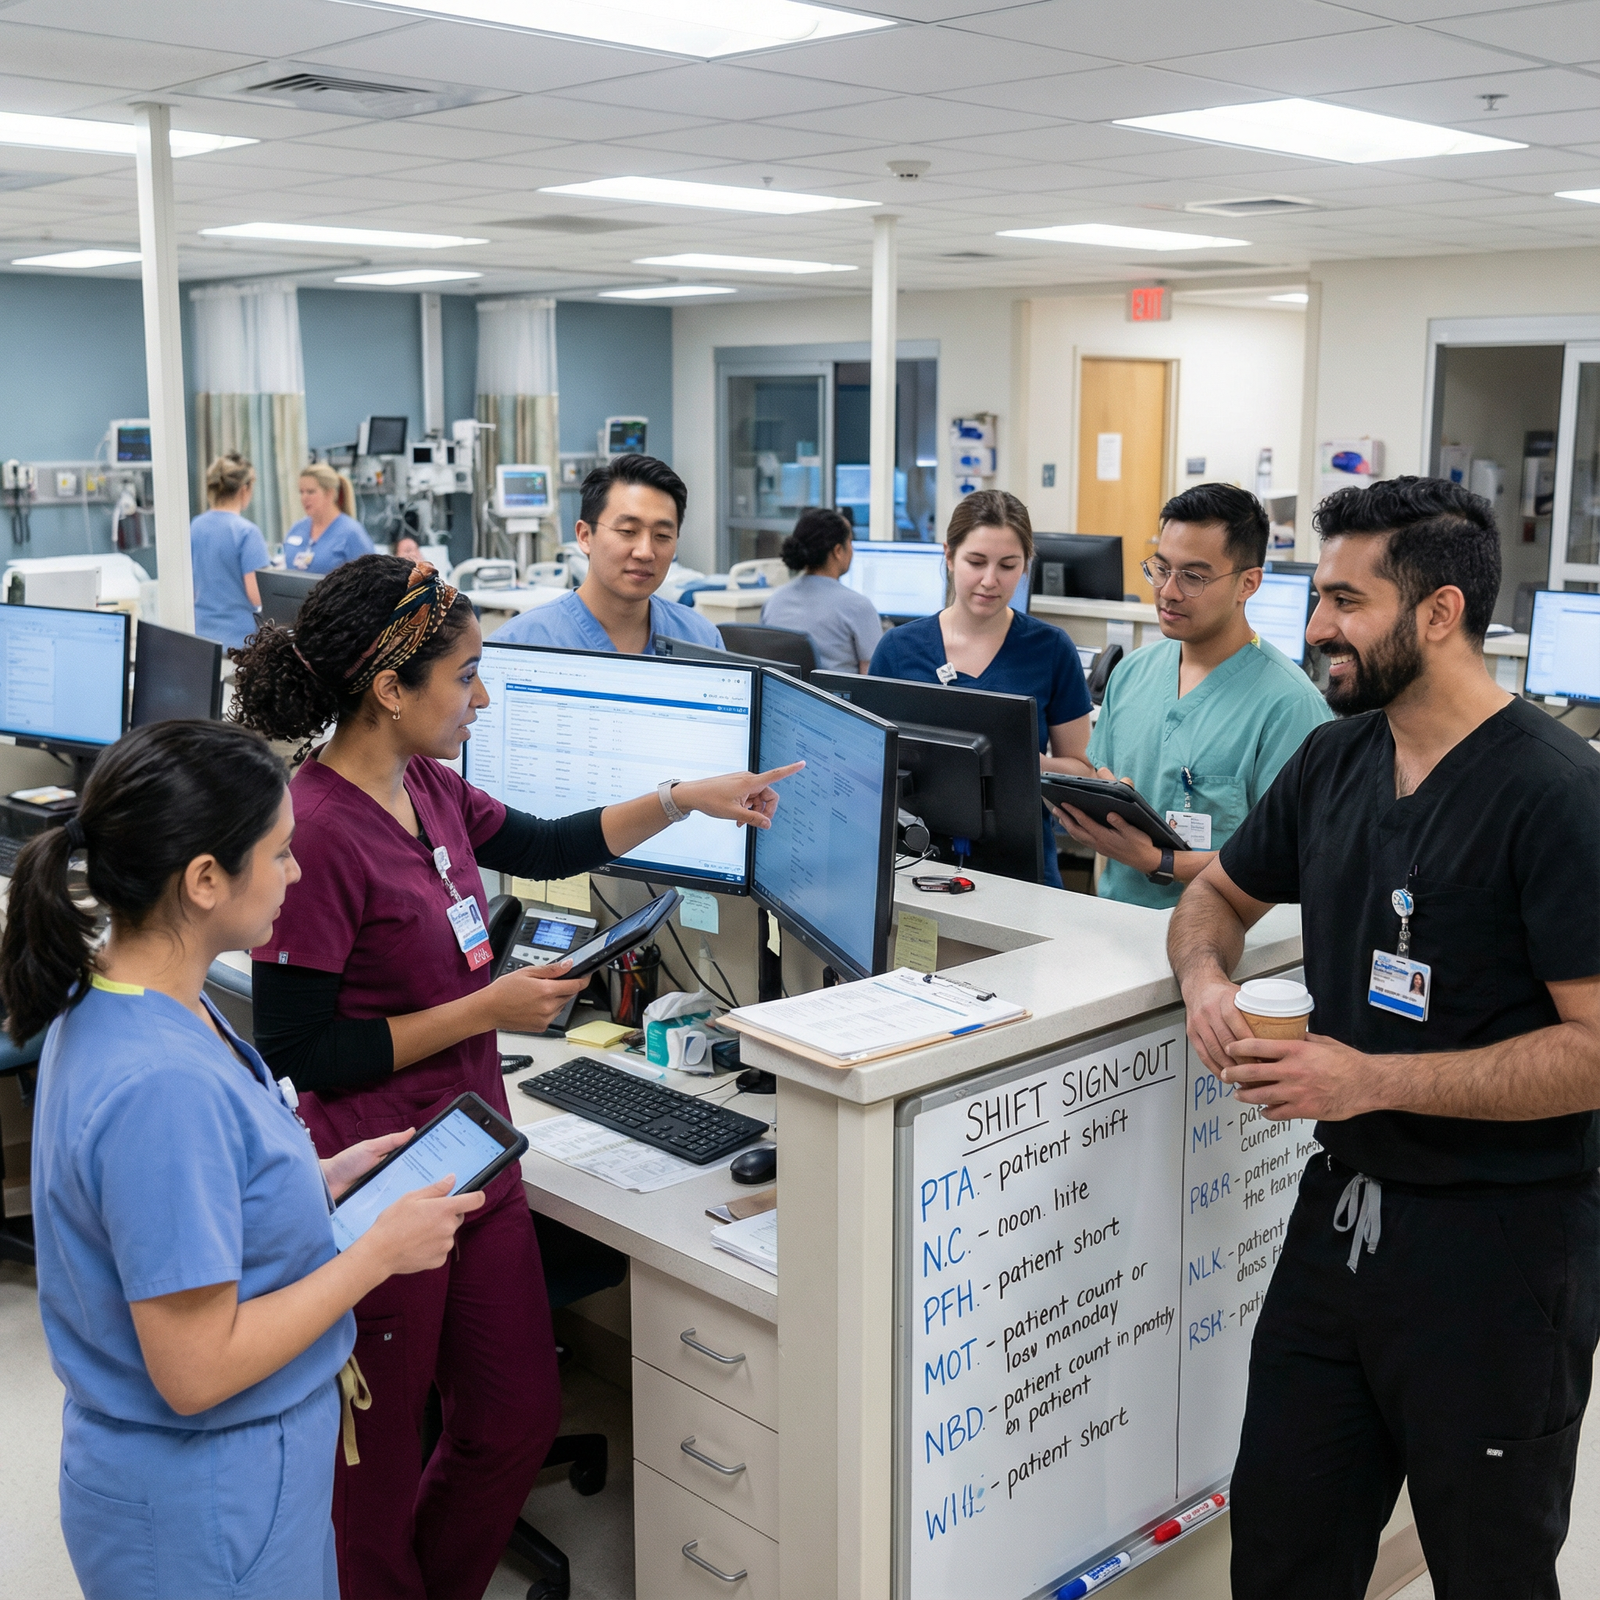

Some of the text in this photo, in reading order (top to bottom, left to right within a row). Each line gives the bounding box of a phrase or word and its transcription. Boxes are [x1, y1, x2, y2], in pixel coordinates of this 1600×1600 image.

[966, 1038, 1176, 1142] SHIFT SIGN-OUT
[1000, 1129, 1071, 1192] patient
[1081, 1108, 1129, 1148] shift
[1244, 1147, 1291, 1189] patient
[1242, 1188, 1265, 1210] the
[999, 1239, 1064, 1300] patient
[1073, 1216, 1120, 1255] short
[1237, 1217, 1285, 1265] patient
[1003, 1294, 1069, 1353] patient
[1076, 1269, 1123, 1308] count
[1131, 1262, 1149, 1281] or
[1045, 1299, 1119, 1349] manoday
[1004, 1362, 1062, 1420] patient
[1068, 1336, 1112, 1374] count
[1117, 1331, 1129, 1347] in
[1029, 1374, 1092, 1433] patient
[1008, 1434, 1072, 1500] patient
